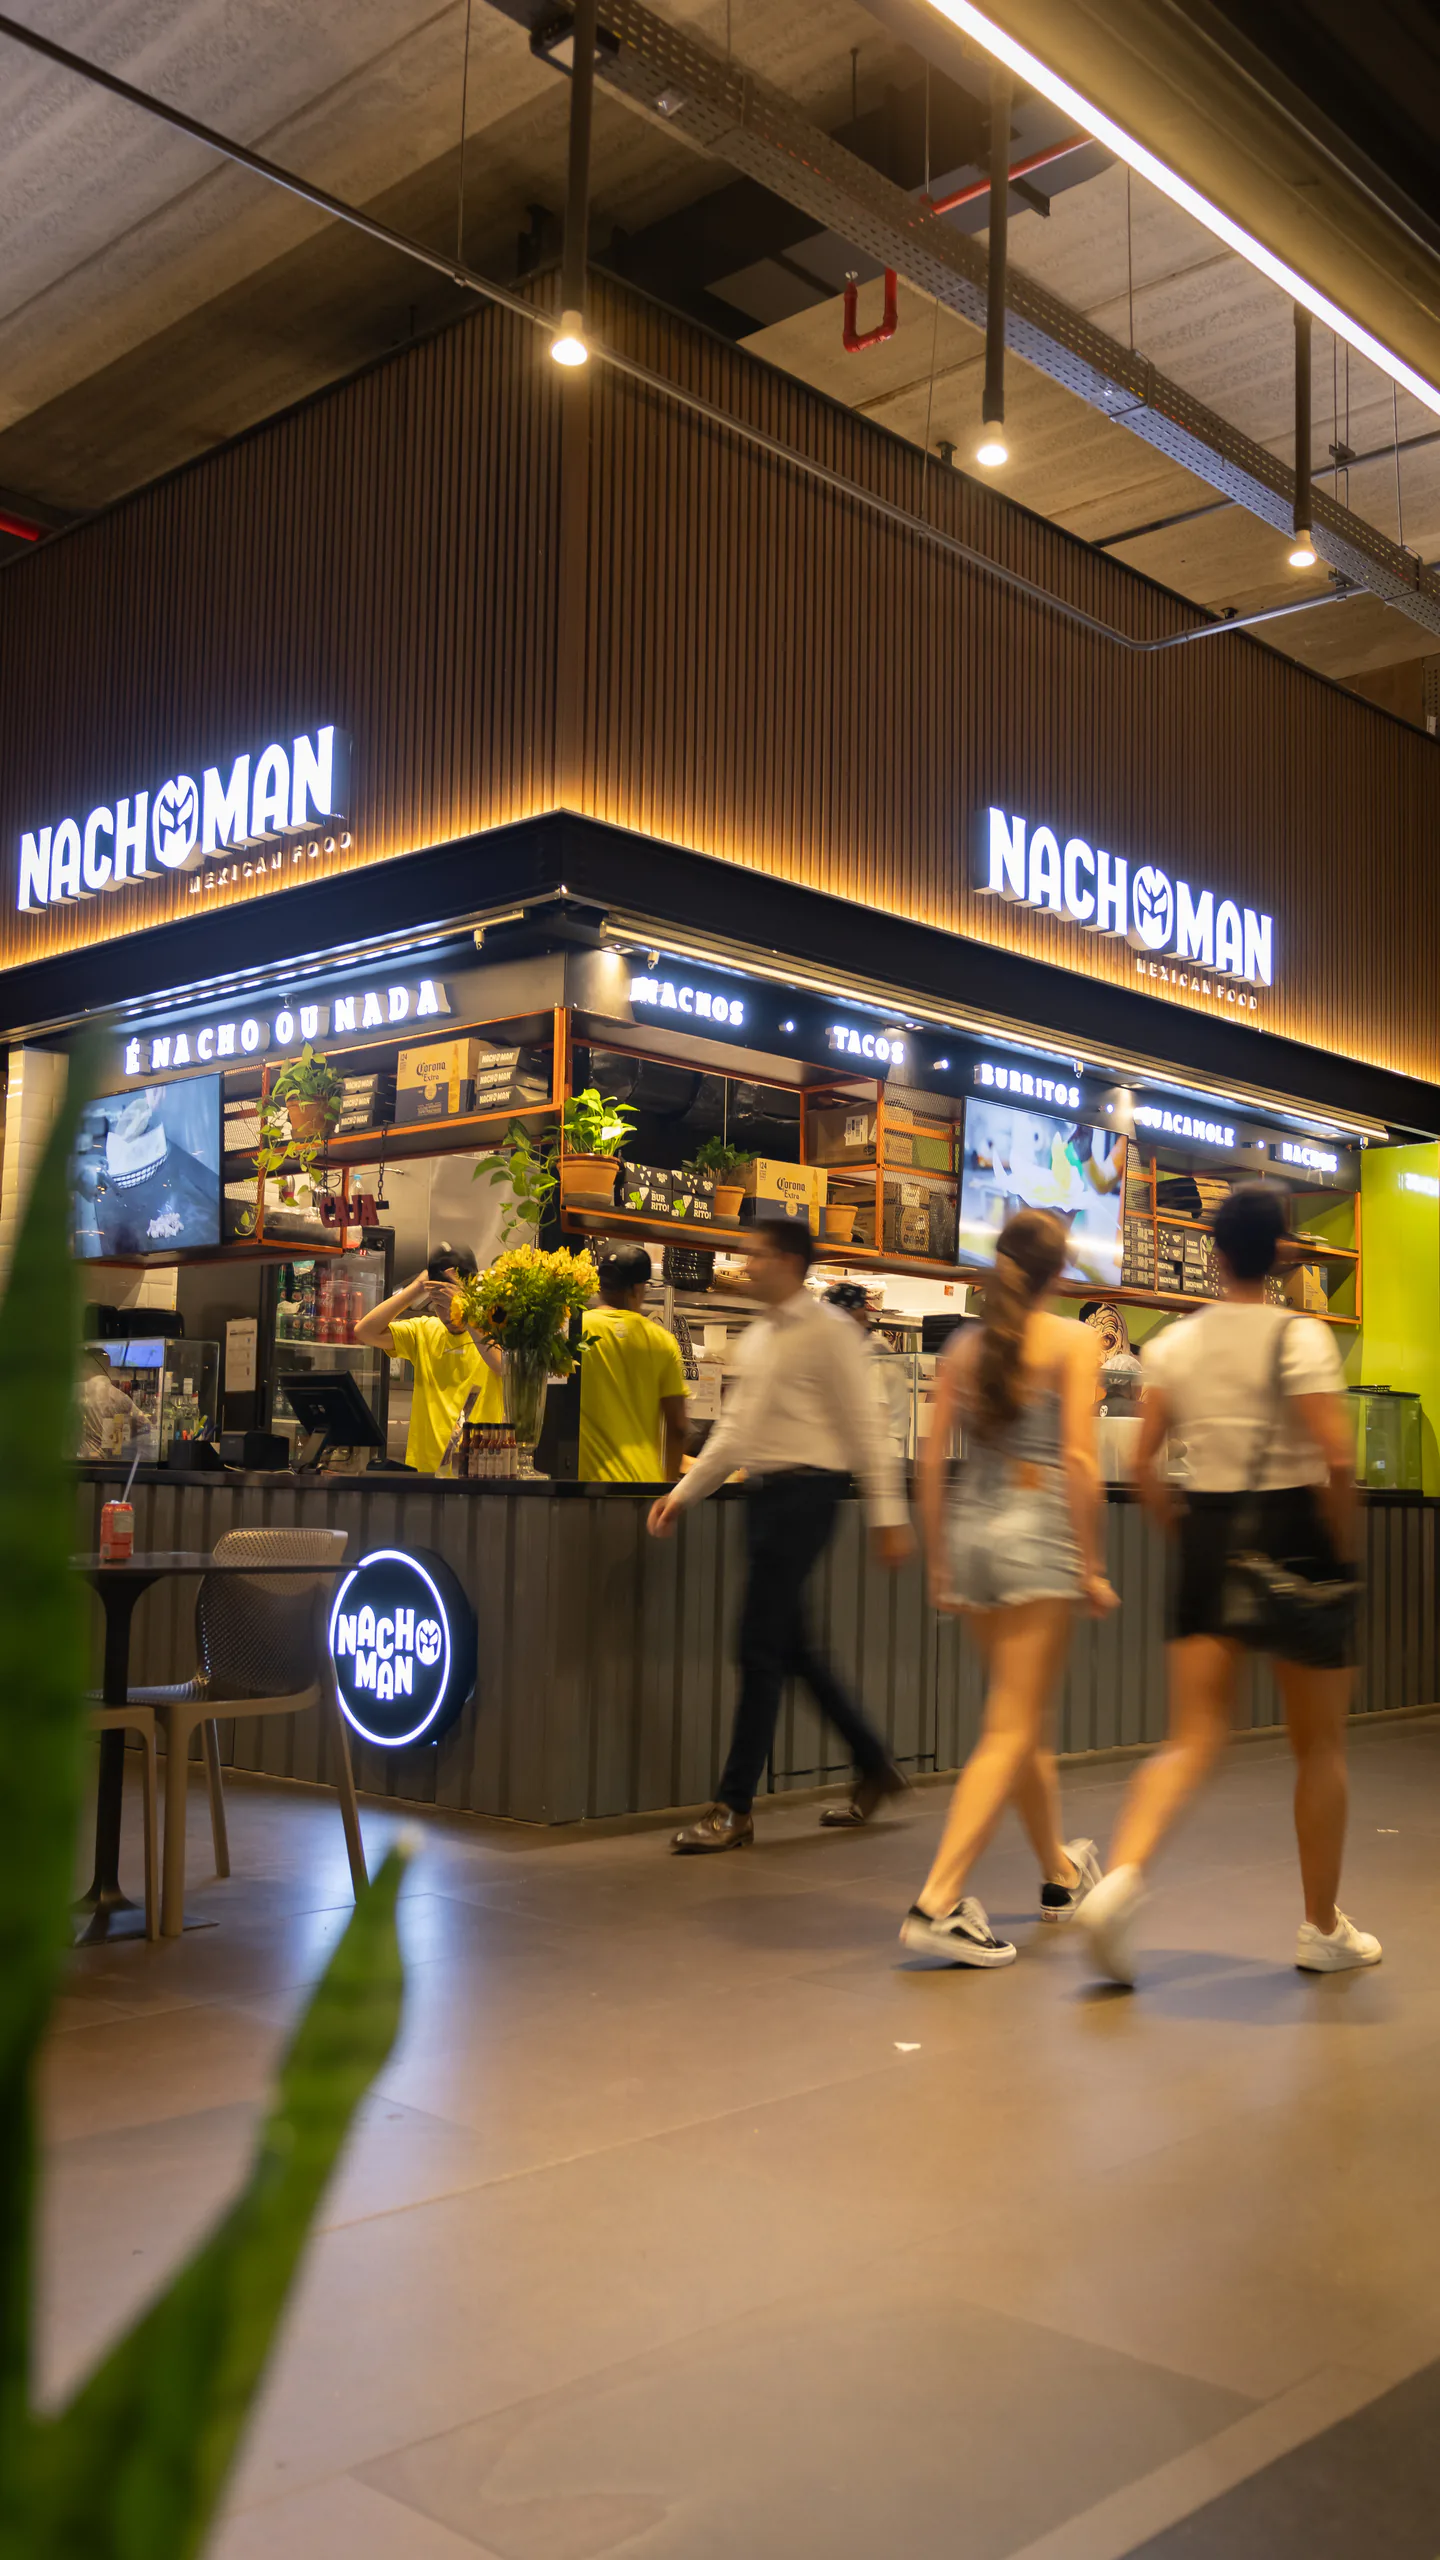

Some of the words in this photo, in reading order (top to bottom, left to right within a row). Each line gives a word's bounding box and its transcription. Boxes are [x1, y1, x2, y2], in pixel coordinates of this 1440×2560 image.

[189, 851, 283, 893] MEXICAN
[292, 830, 352, 863] FOOD
[1136, 957, 1212, 995] MEXICAN
[1217, 984, 1258, 1010] FOOD
[124, 1037, 141, 1075] É
[151, 1018, 260, 1069] NACHO
[274, 1004, 319, 1045] OU
[333, 979, 440, 1033] NADA
[833, 1025, 905, 1064] TACOS
[416, 1061, 446, 1077] Corona
[423, 1074, 440, 1082] Extra
[980, 1062, 1081, 1108] BURRITOS
[776, 1177, 806, 1192] Corona
[784, 1189, 800, 1200] Extra
[651, 1192, 666, 1203] BUR
[651, 1201, 670, 1213] RITO!
[694, 1200, 708, 1211] BUR
[320, 1194, 379, 1228] CAJA
[693, 1209, 712, 1220] RITO!
[337, 1605, 442, 1665] NACHO
[355, 1649, 414, 1700] MAN
